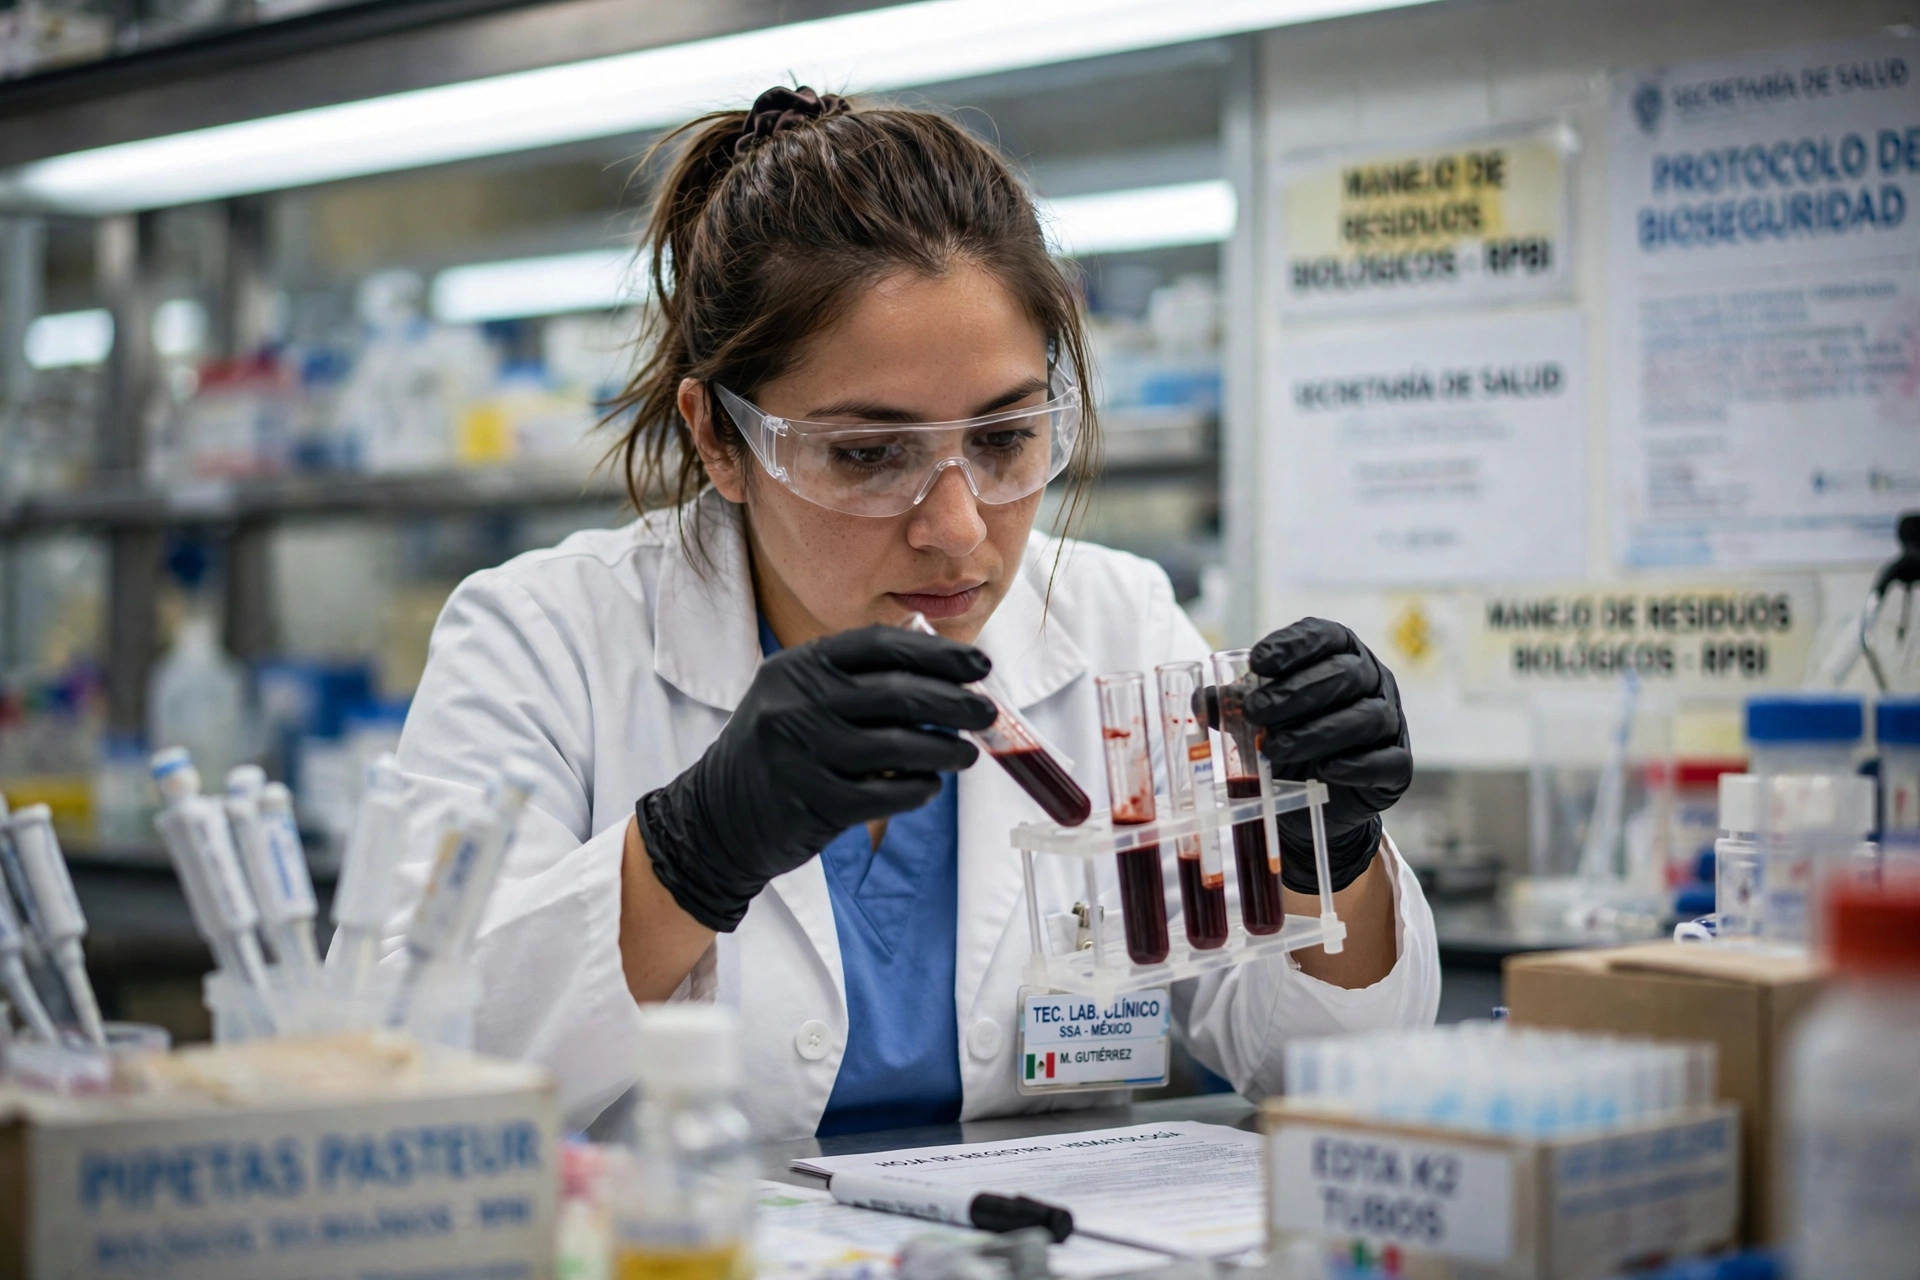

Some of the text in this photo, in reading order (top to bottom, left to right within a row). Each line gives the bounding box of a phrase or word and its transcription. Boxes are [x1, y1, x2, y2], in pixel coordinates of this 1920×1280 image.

[1802, 66, 1832, 97] DE
[1836, 58, 1909, 93] SALUD
[1343, 151, 1506, 196] MANEJO DE
[1652, 127, 1920, 194] PROTOCOLO DE
[1638, 184, 1907, 251] BIOSEGURIDAD
[1442, 368, 1472, 400] DE
[1481, 361, 1565, 398] SALUD
[1487, 594, 1790, 632] MANEJO DE RESIDUOS
[1033, 1006, 1064, 1023] TEC.
[1070, 1004, 1099, 1020] LAB.
[1059, 1025, 1082, 1038] SSA
[1091, 1020, 1132, 1035] MÉXICO
[1060, 1047, 1132, 1064] M. GUTIÉRREZ
[80, 1119, 542, 1214] PIPETAS PASTEUR
[874, 1158, 933, 1168] HOJA
[930, 1154, 960, 1163] DE
[959, 1146, 1052, 1159] REGISTRO
[1310, 1134, 1402, 1184] EDTA
[1410, 1152, 1462, 1197] K2
[1319, 1185, 1449, 1246] TUBOS
